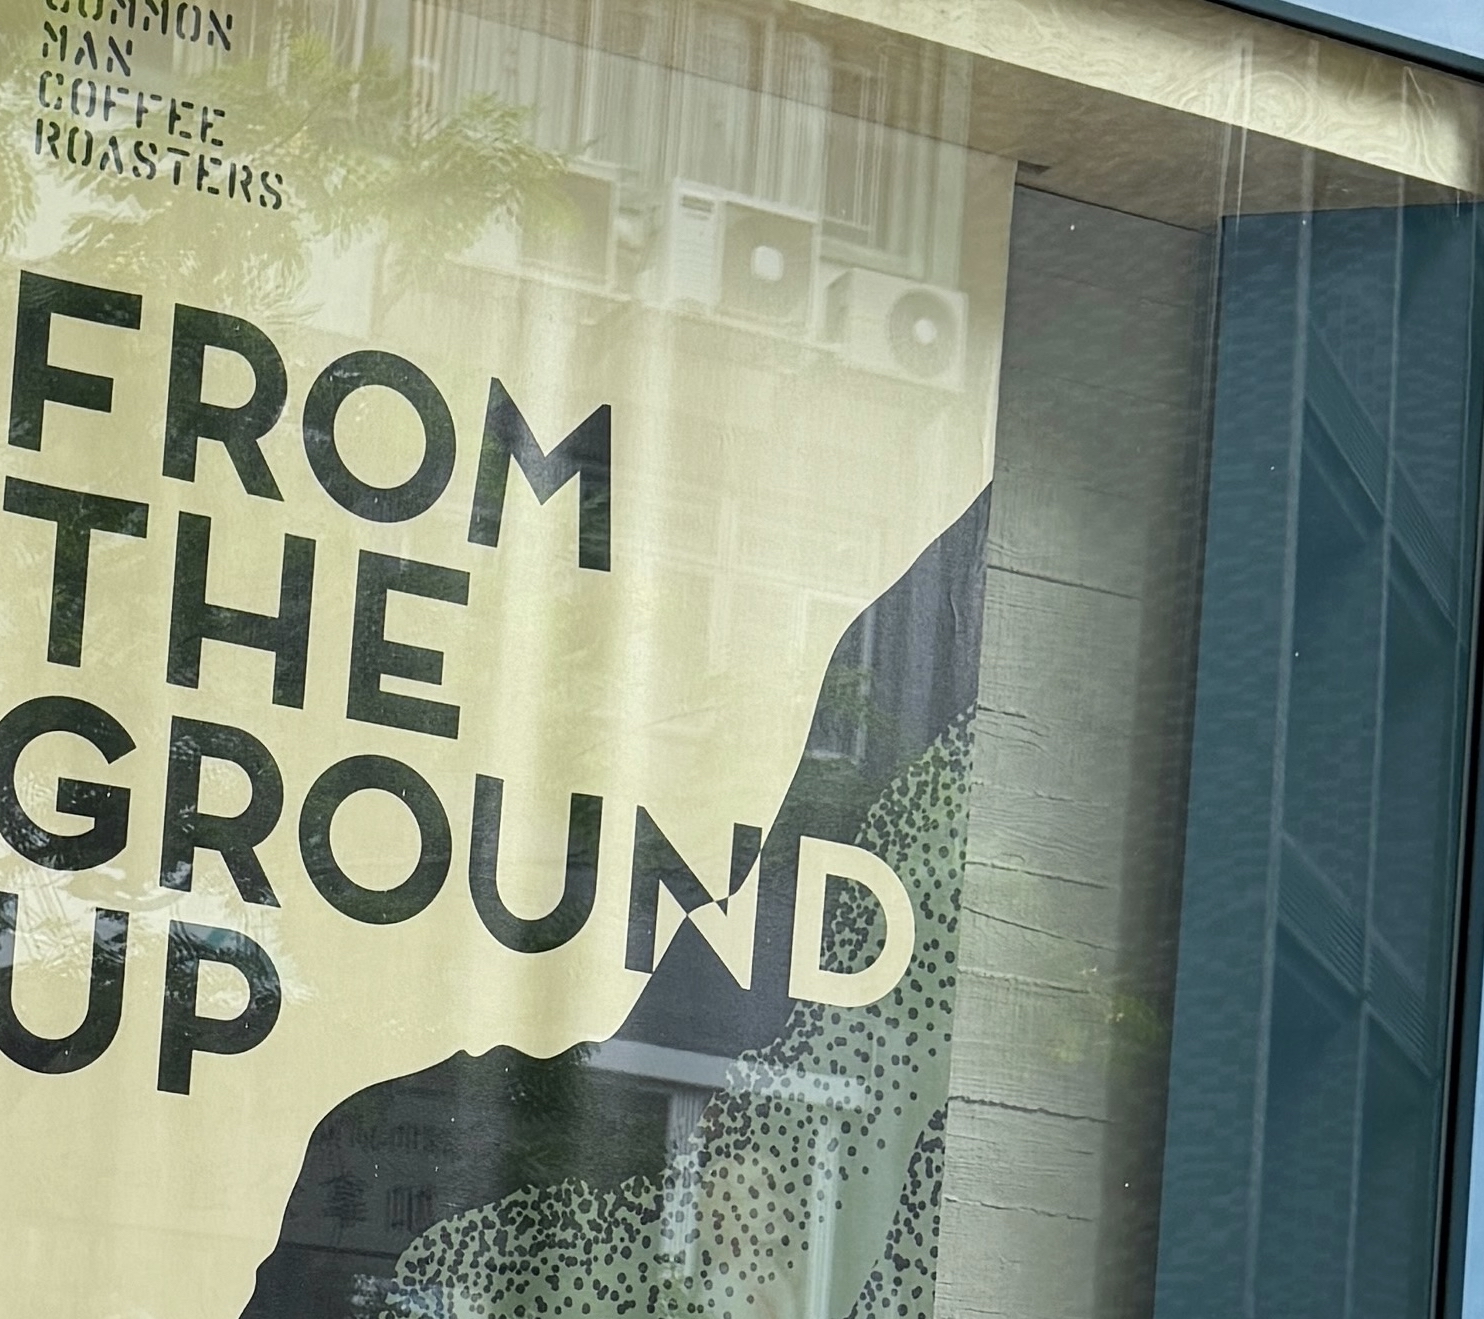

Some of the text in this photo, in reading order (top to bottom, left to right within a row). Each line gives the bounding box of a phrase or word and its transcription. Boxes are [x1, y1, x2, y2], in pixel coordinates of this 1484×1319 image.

[42, 21, 133, 77] MAN
[39, 70, 226, 147] COFFEE
[35, 118, 283, 210] ROASTERS
[7, 269, 613, 573] FROM
[2, 475, 472, 740] THE
